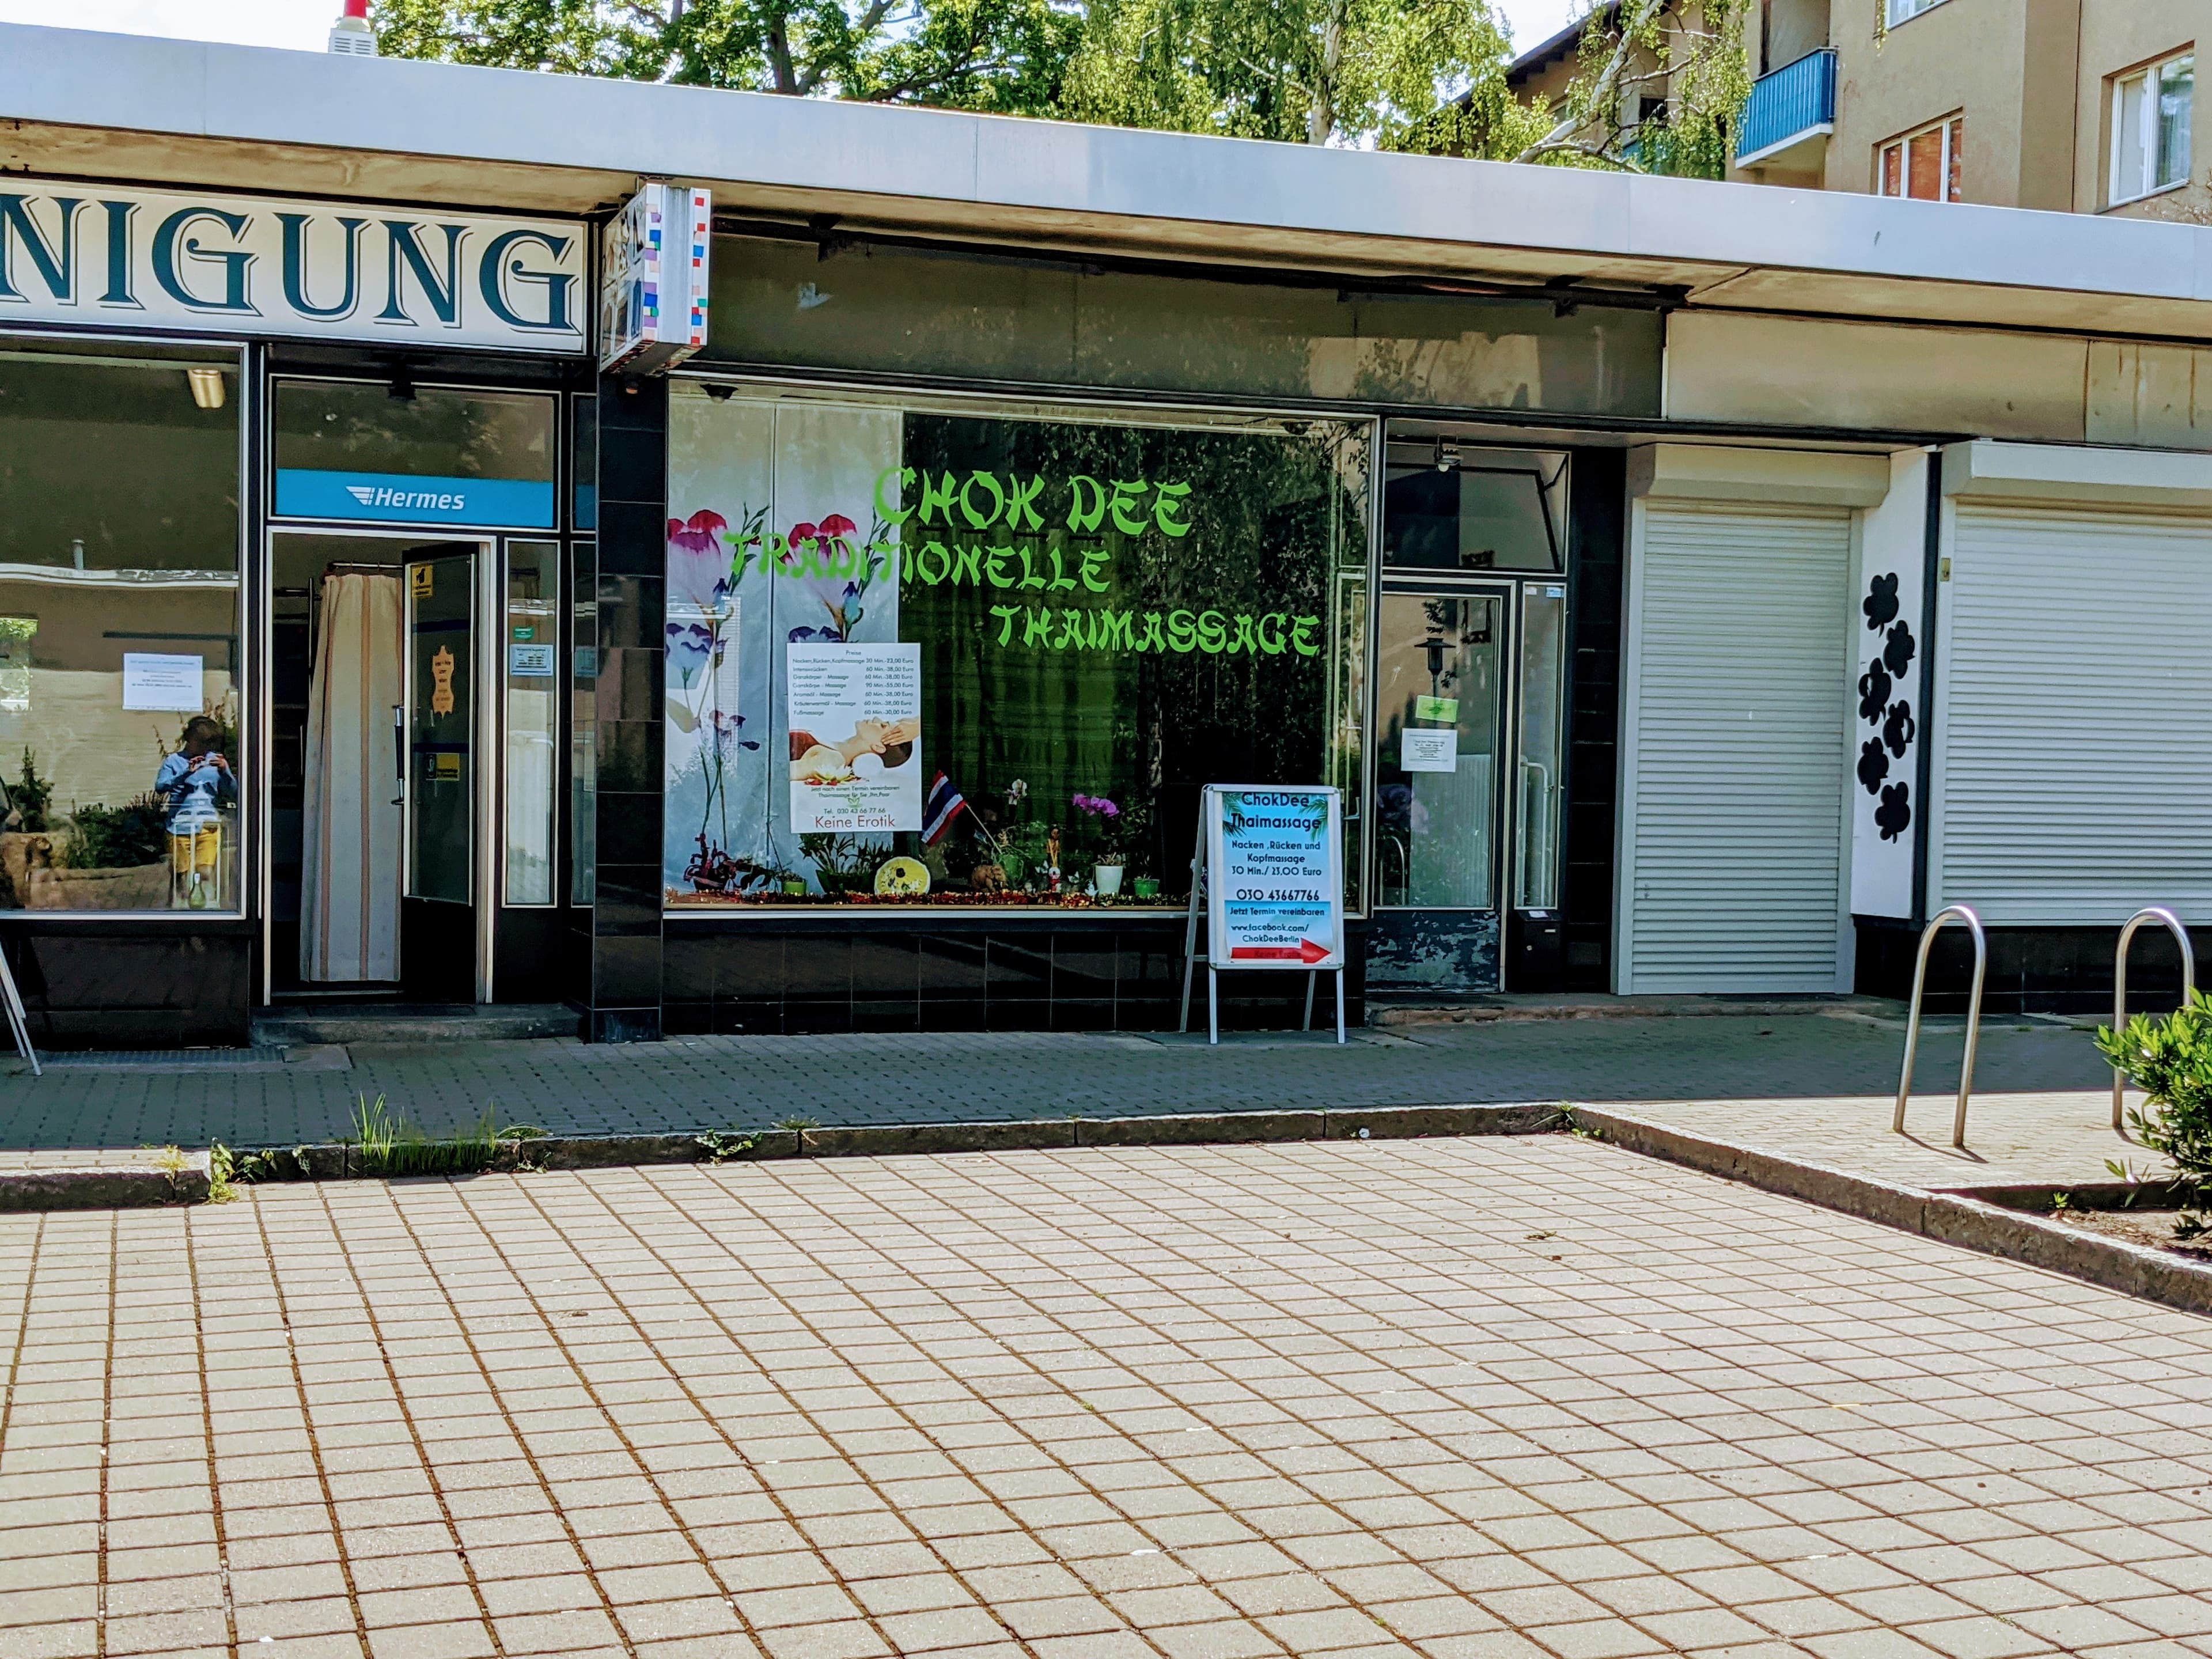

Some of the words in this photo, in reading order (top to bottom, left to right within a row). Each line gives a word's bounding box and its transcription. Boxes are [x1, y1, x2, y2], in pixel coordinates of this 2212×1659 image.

[375, 487, 465, 510] Hermes
[874, 465, 1046, 532] CHOK
[1067, 474, 1194, 537] DEE
[724, 532, 1112, 593] TRADITIONELLE
[990, 604, 1321, 654] THAIMASSAGE
[1241, 792, 1310, 807] ChokDee
[815, 814, 853, 829] Keine
[858, 814, 896, 828] Erotik
[1231, 813, 1321, 831] Thaimassage
[1232, 840, 1264, 849] Nacken
[1305, 842, 1321, 850] und
[1247, 853, 1305, 865] Kopfmassage
[1232, 866, 1244, 875] 30
[1302, 867, 1322, 876] Euro
[1236, 889, 1264, 901] 030
[1267, 889, 1320, 902] 43667766
[1230, 906, 1248, 915] Jetzt
[1249, 907, 1276, 916] Termin
[1277, 907, 1325, 916] vereinbaren
[1243, 934, 1300, 943] ChokDeeBerlin
